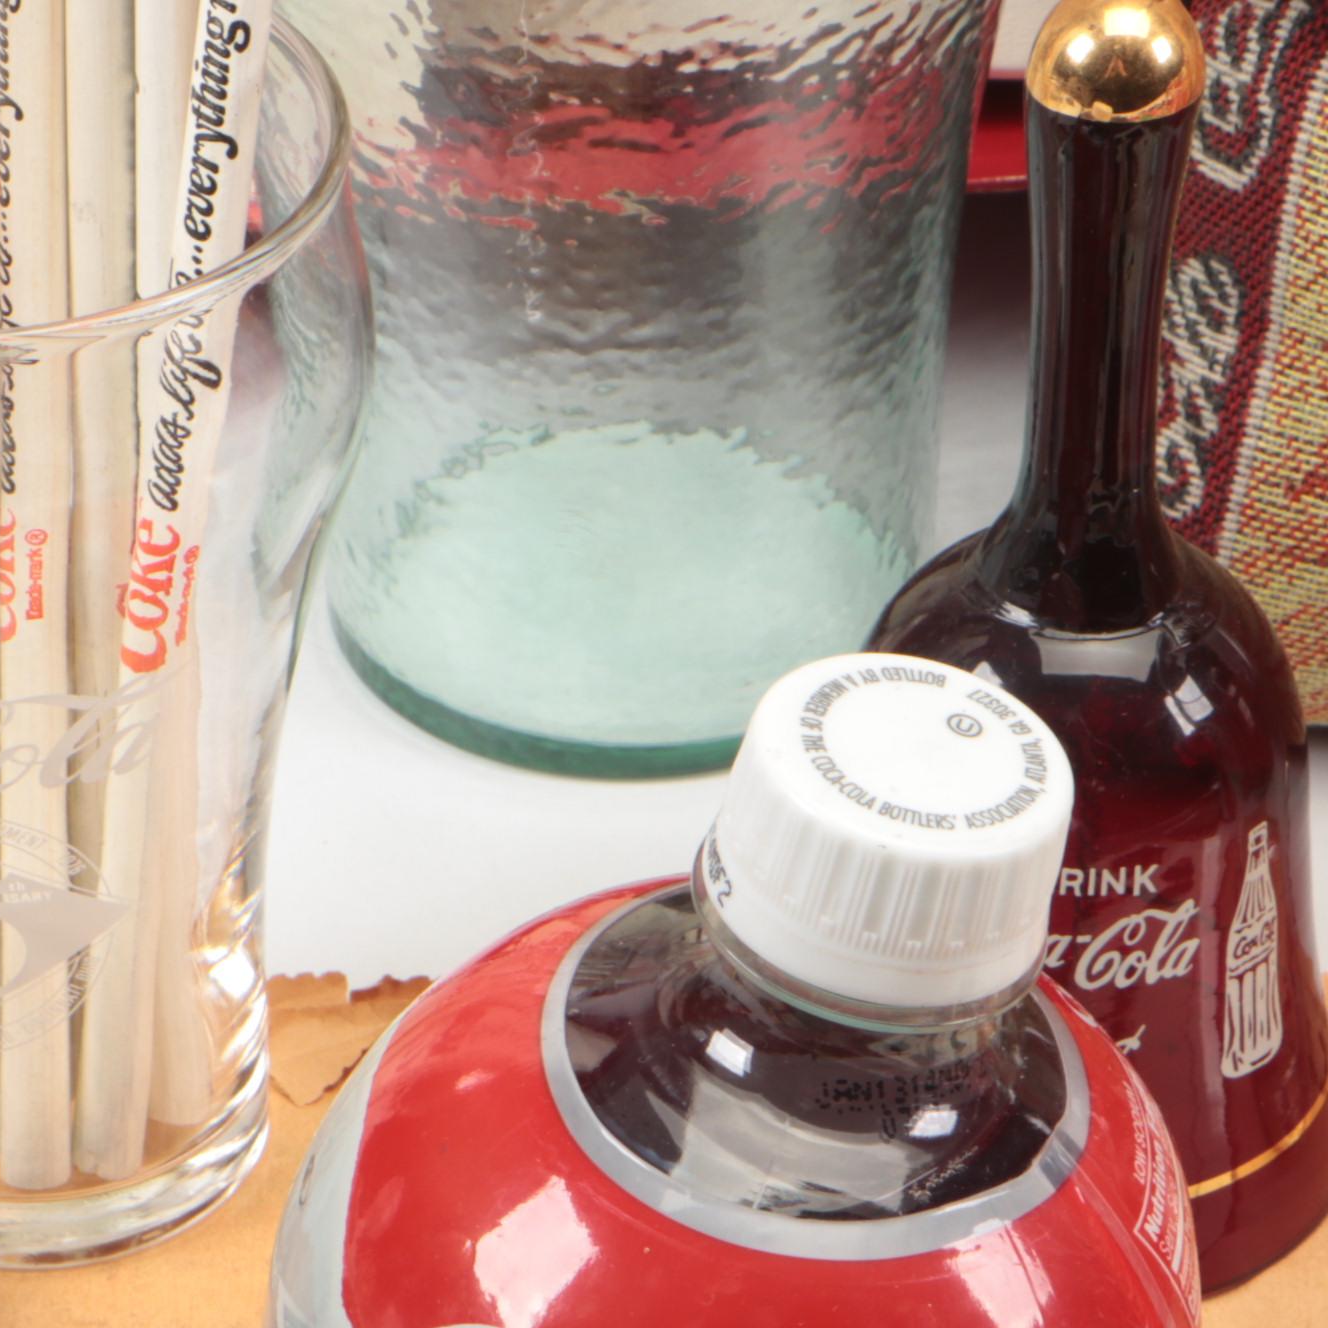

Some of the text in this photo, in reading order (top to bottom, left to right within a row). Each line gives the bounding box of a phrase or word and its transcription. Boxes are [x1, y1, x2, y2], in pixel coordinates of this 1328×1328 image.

[119, 518, 181, 673] Coke
[843, 674, 859, 688] A
[858, 668, 880, 685] BY
[882, 667, 947, 689] BOTTLED
[803, 681, 850, 718] MEMBER
[800, 716, 823, 732] OF
[1008, 719, 1032, 735] GA
[801, 734, 828, 753] THE
[811, 755, 876, 811] COCA-COLA
[1059, 863, 1159, 897] RINK
